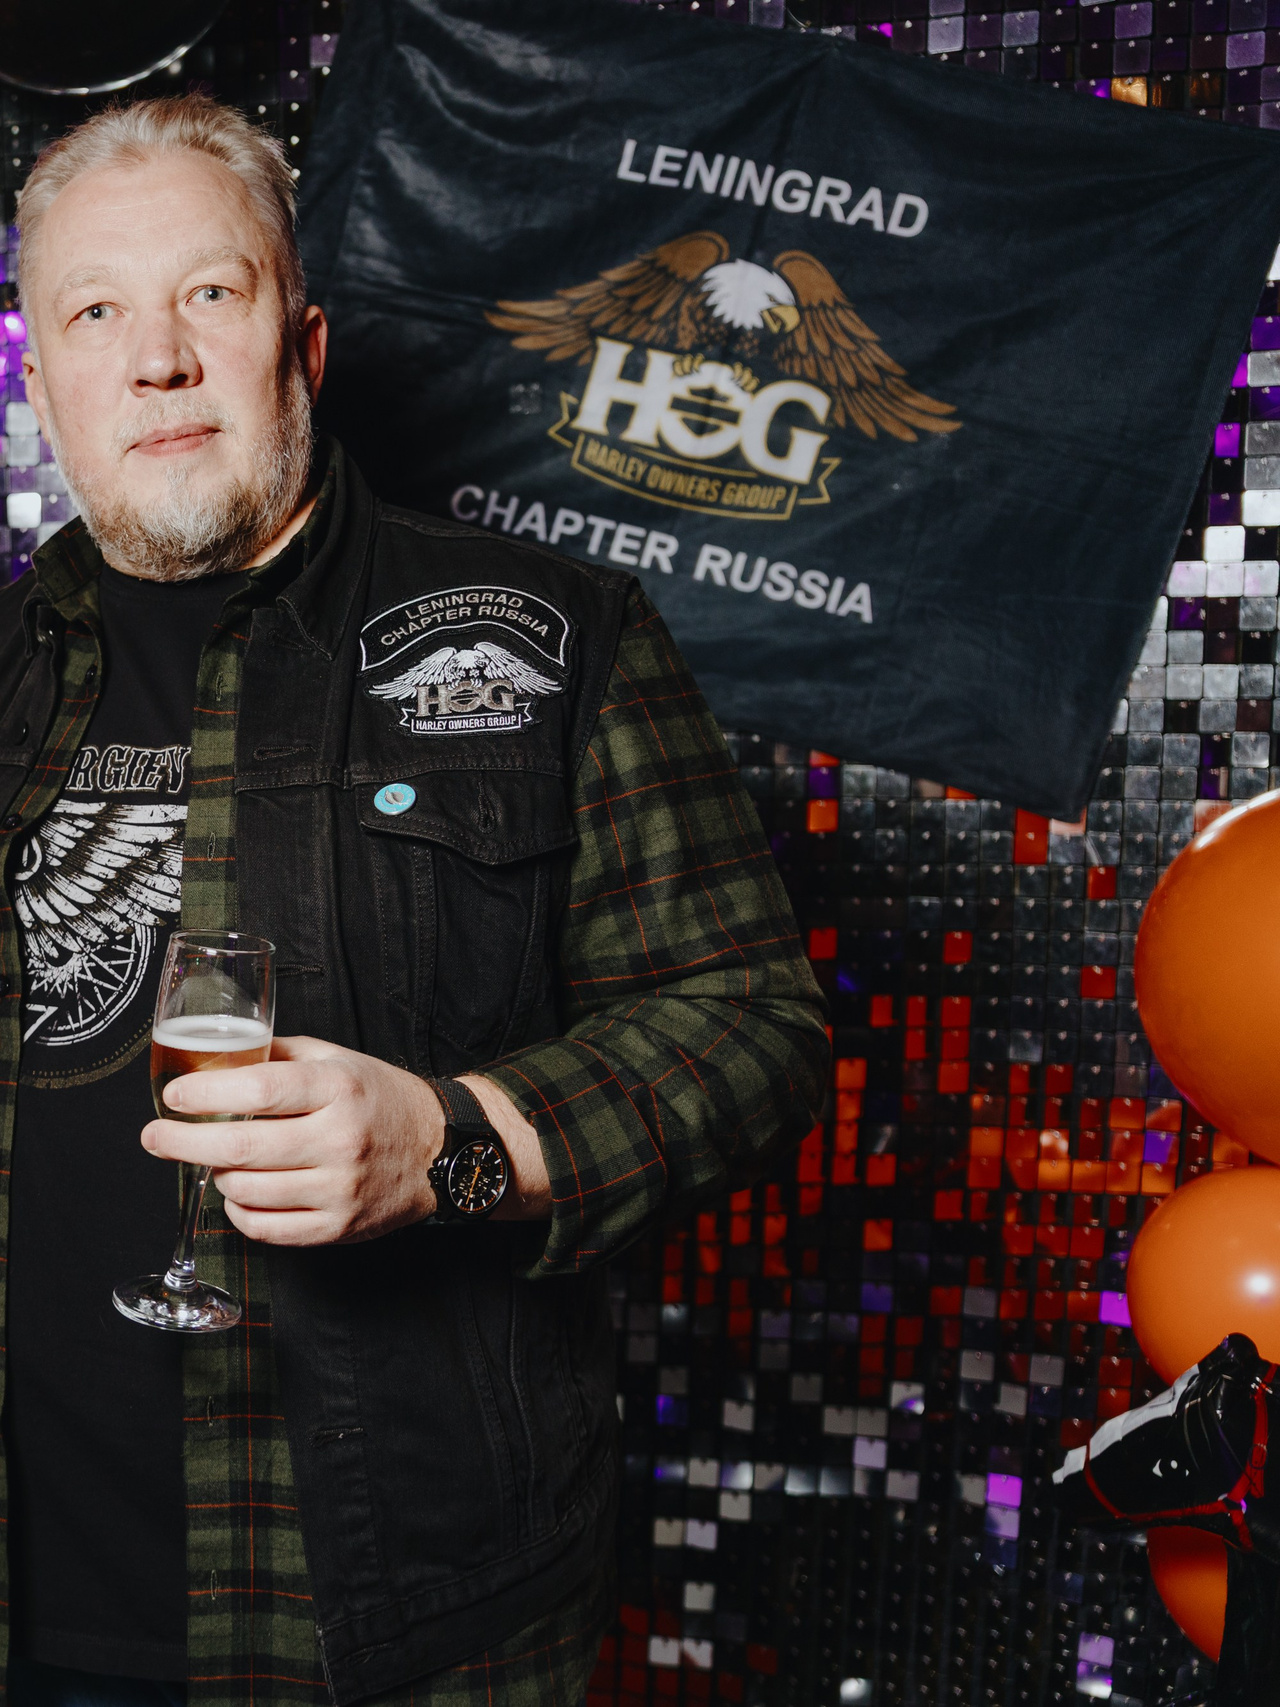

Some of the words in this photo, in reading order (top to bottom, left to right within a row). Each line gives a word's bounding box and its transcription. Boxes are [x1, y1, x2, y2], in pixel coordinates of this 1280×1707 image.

[617, 139, 929, 238] LENINGRAD
[571, 336, 830, 485] HOG
[584, 438, 649, 483] HARLEY
[646, 464, 722, 503] OWNERS
[721, 481, 787, 510] GROUP
[451, 484, 679, 573] CHAPTER
[694, 544, 874, 624] RUSSIA
[380, 606, 472, 646] CHAPTER
[477, 605, 550, 637] RUSSIA
[405, 592, 523, 620] LENINGRAD
[415, 679, 515, 717] HOG
[416, 720, 447, 731] HARLEY
[448, 718, 486, 729] OWNERS
[487, 715, 517, 727] GROUP
